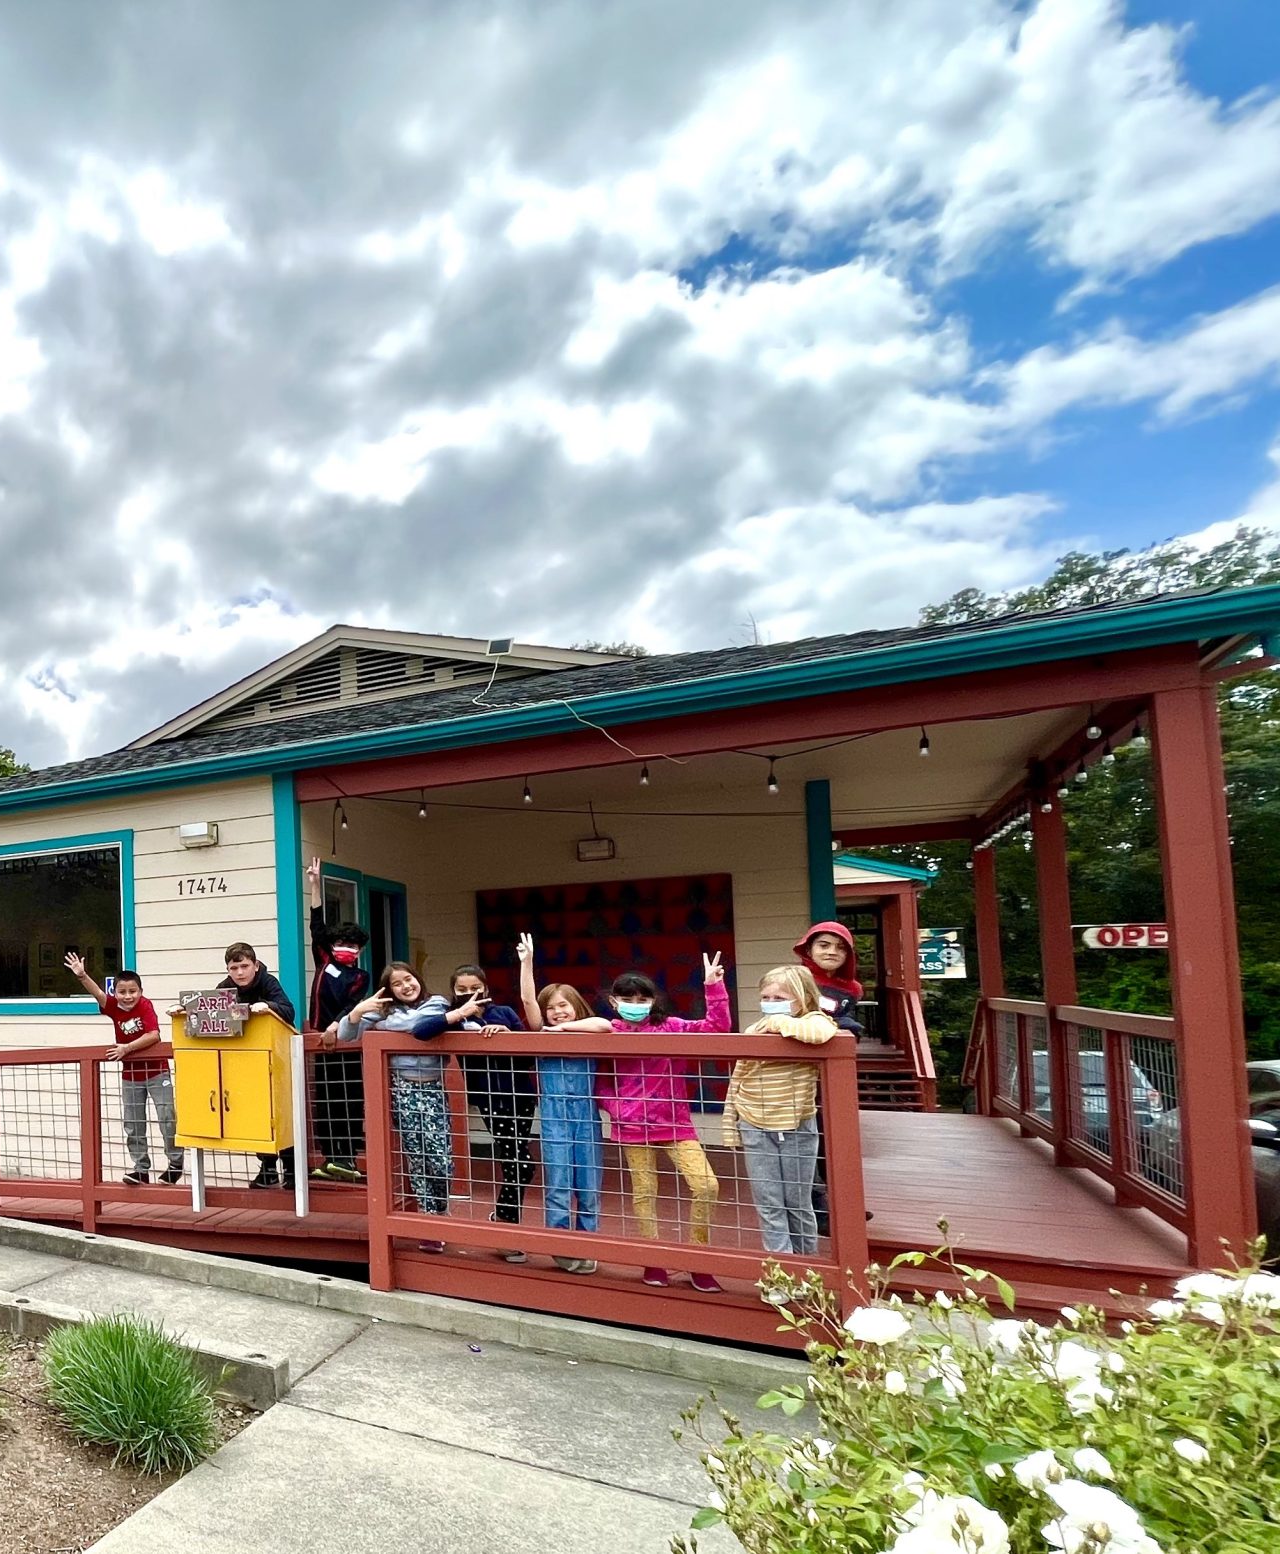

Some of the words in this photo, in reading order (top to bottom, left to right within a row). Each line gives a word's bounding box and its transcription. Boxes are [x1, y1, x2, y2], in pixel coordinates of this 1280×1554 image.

[55, 847, 120, 870] EVENTS
[177, 876, 228, 896] 17474
[1097, 926, 1168, 946] OPE
[197, 996, 229, 1012] ART
[199, 1019, 230, 1034] ALL
